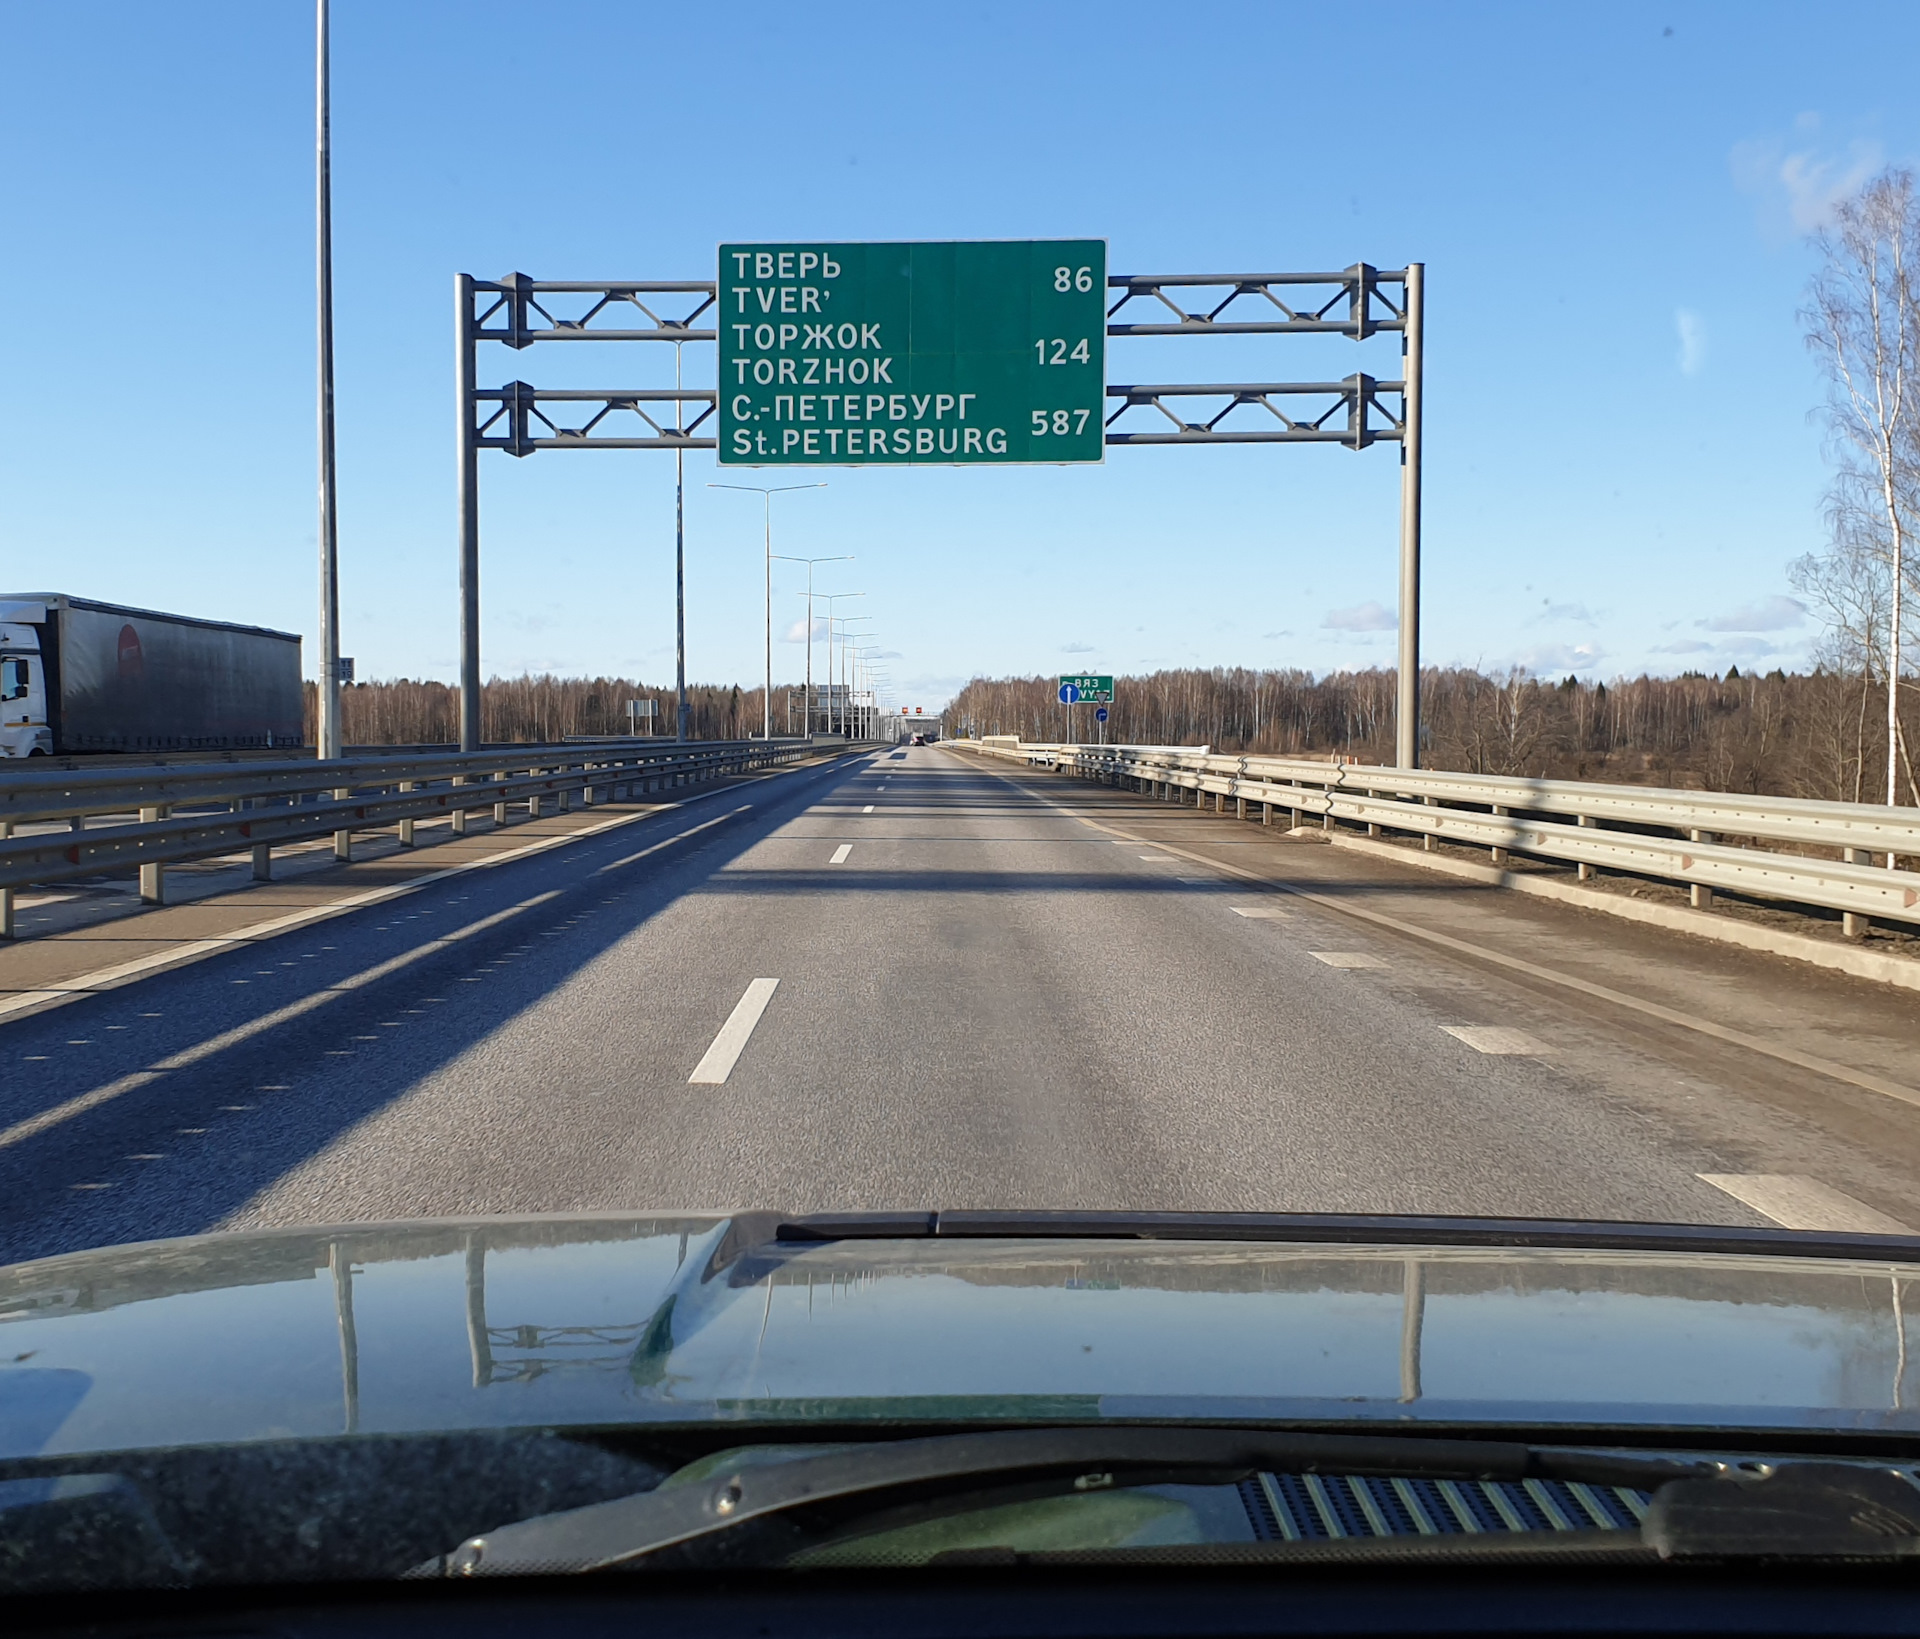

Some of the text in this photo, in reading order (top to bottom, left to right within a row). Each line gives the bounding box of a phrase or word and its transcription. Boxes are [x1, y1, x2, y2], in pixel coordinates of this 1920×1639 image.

[732, 252, 841, 279] ТВЕРЬ
[1054, 266, 1093, 293] 86
[732, 286, 830, 313] TVER'
[732, 323, 882, 350] ТОРЖОК
[1035, 338, 1091, 365] 124
[732, 357, 893, 385] TORZHOK
[732, 393, 976, 421] С.-ПЕТЕРБУРГ
[1031, 409, 1091, 436] 587
[1074, 678, 1099, 688] ВЯЗ
[1080, 689, 1110, 699] VY
